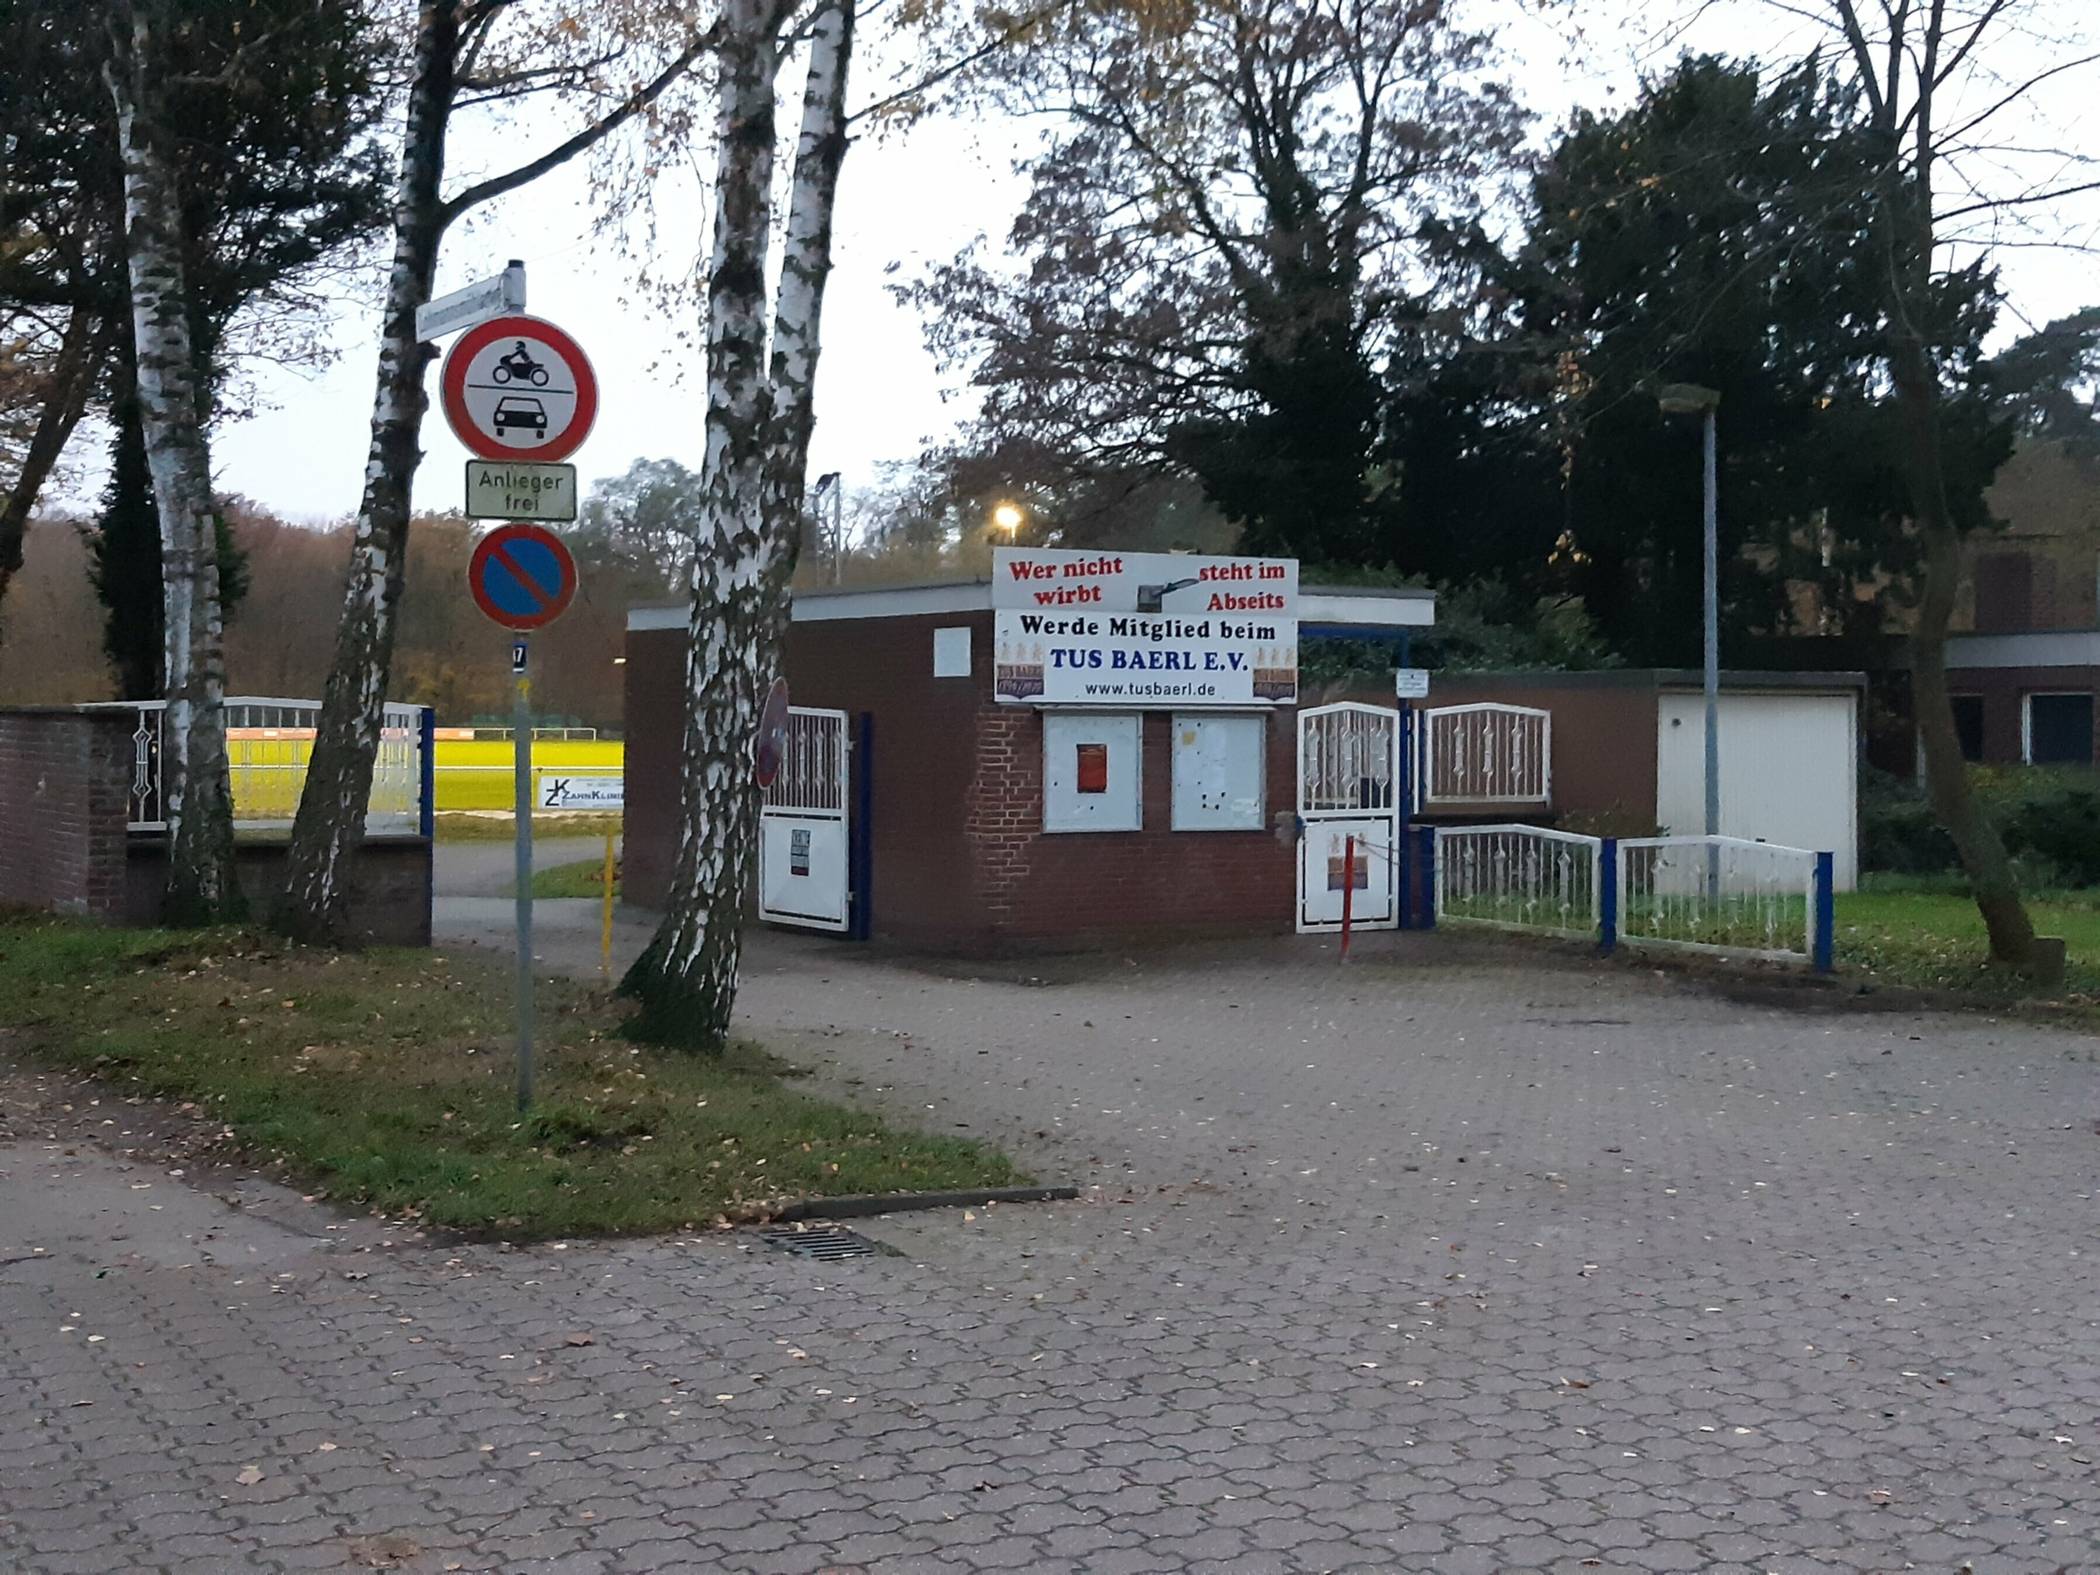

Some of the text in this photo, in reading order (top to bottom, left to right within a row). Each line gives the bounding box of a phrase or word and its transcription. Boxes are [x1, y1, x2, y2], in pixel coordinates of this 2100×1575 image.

[479, 469, 564, 493] Anlieger
[505, 493, 539, 511] frei
[1009, 556, 1123, 581] Wer nicht
[1199, 561, 1286, 581] steht im
[1033, 585, 1102, 606] wirbt
[1207, 591, 1285, 612] Abseits
[1020, 614, 1276, 641] Werde Mitglied beim
[1050, 648, 1249, 671] TUS BAERL E.V.
[1085, 681, 1216, 697] www.tusbaerl.de
